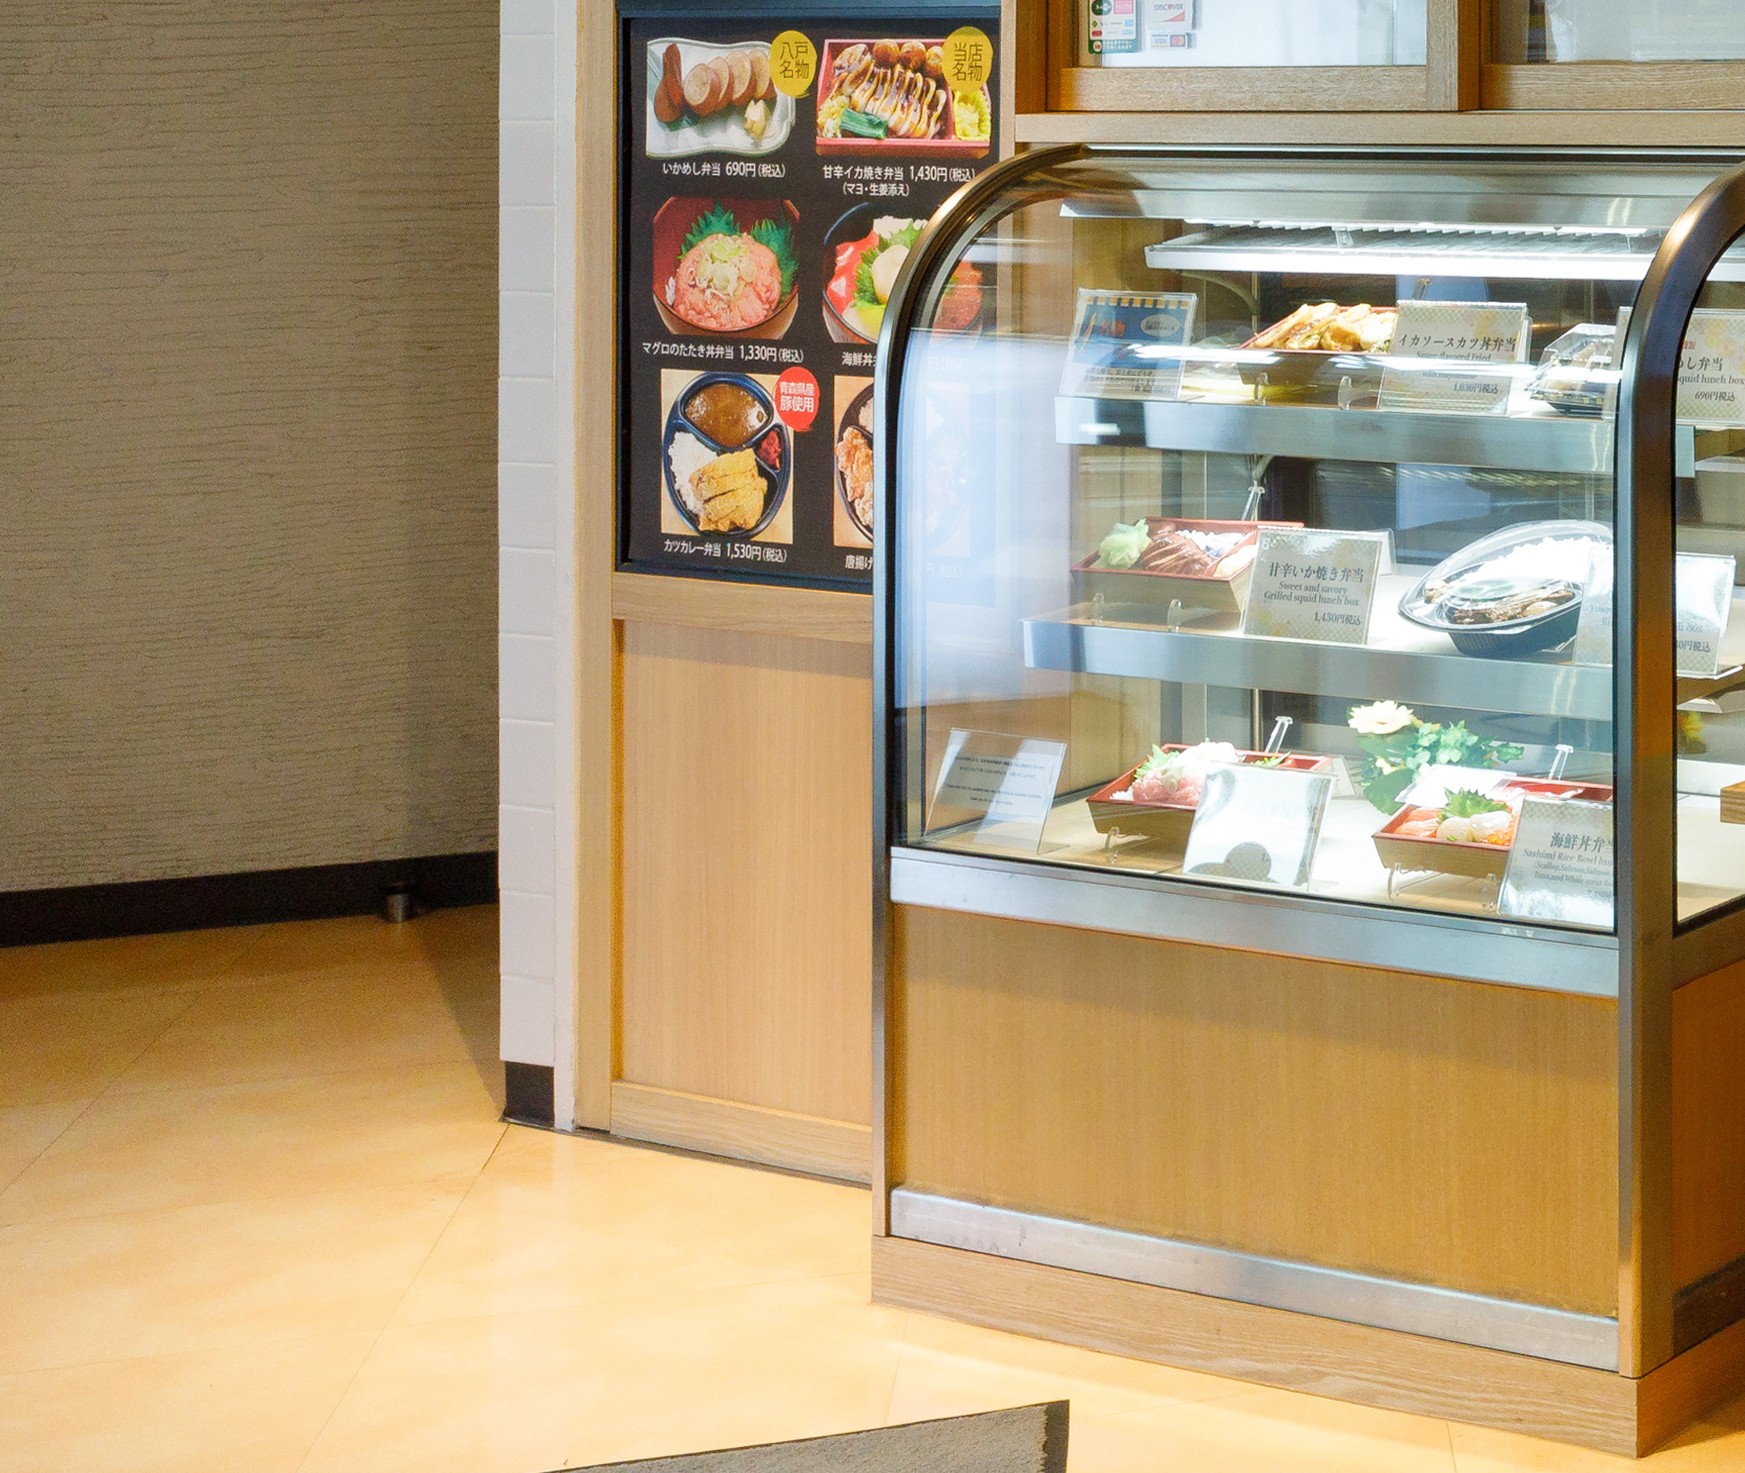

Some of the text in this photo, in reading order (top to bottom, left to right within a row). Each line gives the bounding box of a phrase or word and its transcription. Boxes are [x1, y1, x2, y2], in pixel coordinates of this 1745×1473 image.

[779, 41, 809, 60] 八戸
[953, 42, 984, 61] 当店
[779, 60, 811, 80] 名物
[952, 61, 983, 82] 名物
[662, 162, 721, 177] いかめし弁当
[822, 165, 905, 181] 甘辛イカ焼き弁当
[642, 342, 735, 359] マグロのたたき丼弁当
[1399, 334, 1517, 353] イカソースカツ丼弁当
[1701, 374, 1726, 385] lunch
[1728, 375, 1745, 386] box
[780, 396, 816, 413] 豚使用
[663, 538, 722, 558] カツカレー弁当
[1269, 561, 1364, 584] 甘辛いか焼き弁当
[1278, 580, 1303, 591] Sweet
[1304, 582, 1320, 592] and
[1264, 590, 1360, 606] Grilled squid lunch box
[1523, 848, 1613, 867] Sashimi Rice Bowl lun
